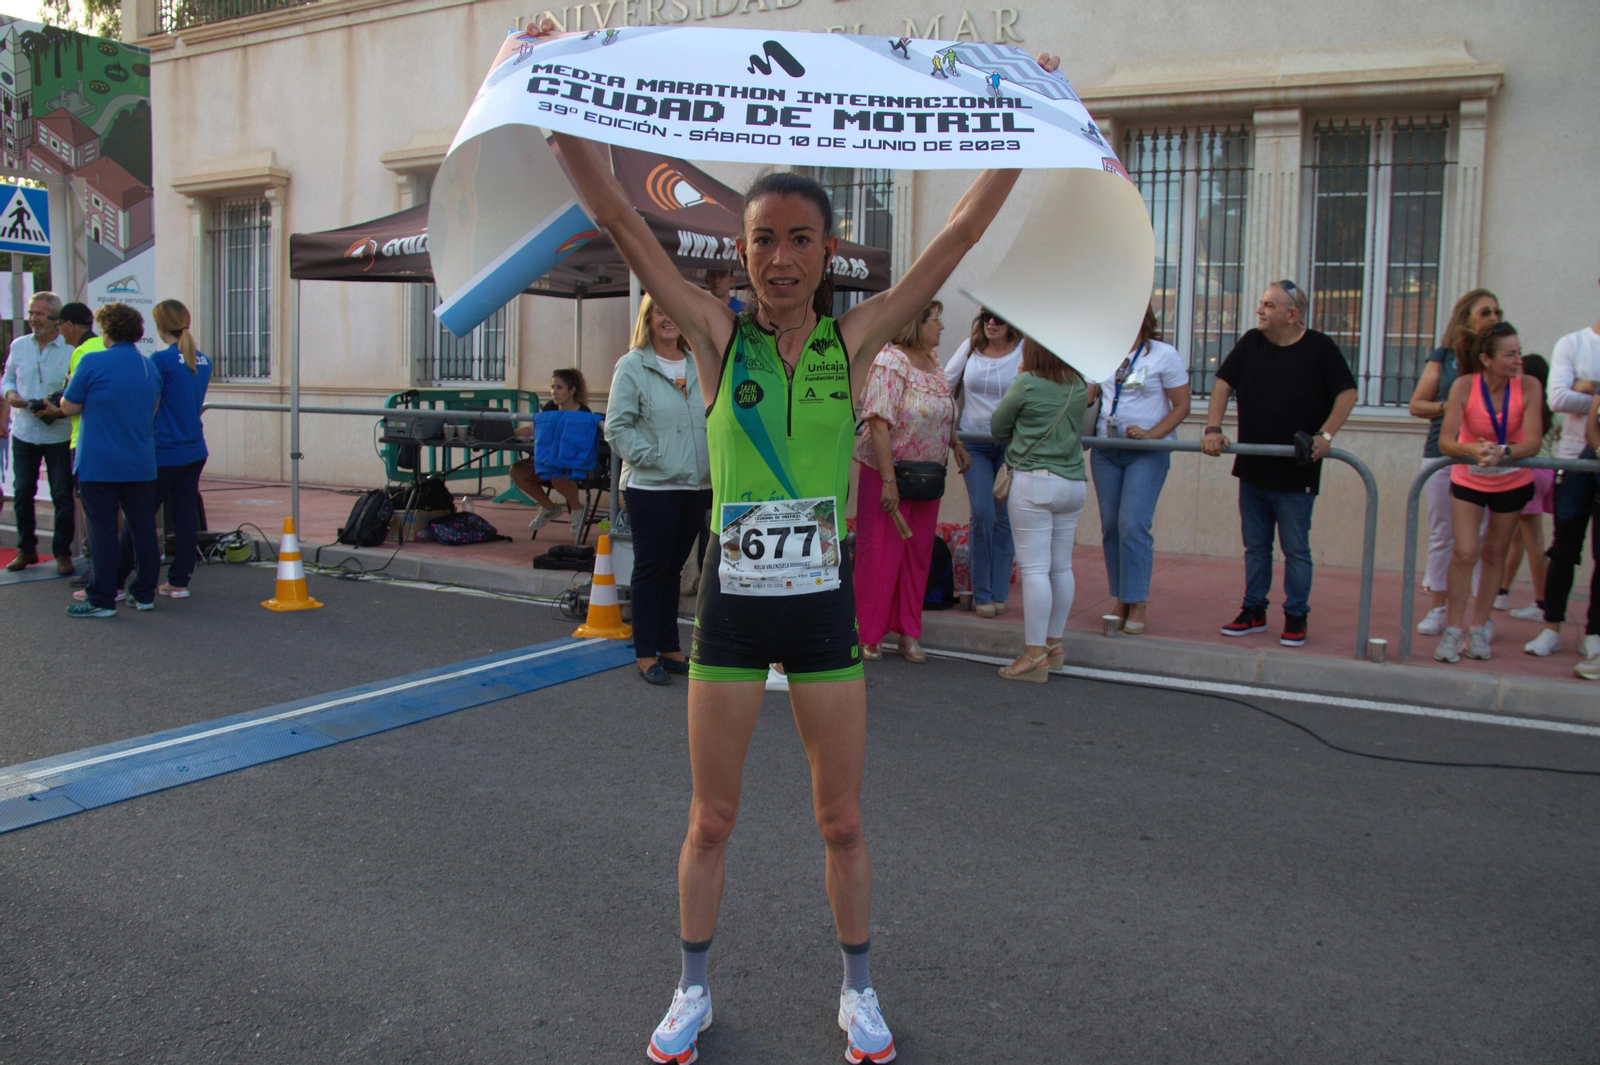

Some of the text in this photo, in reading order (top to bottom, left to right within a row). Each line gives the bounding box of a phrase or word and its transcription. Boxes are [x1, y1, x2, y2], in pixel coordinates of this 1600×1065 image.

[513, 0, 801, 33] NIVERSID
[902, 7, 1024, 43] MAR
[527, 76, 1035, 133] CIUDAD DE MOTRIL
[531, 64, 1033, 109] MEDIA MARATHON INTERNACIONAL
[584, 112, 667, 137] EDICIÓN
[689, 127, 781, 145] SÁBADO
[788, 135, 810, 147] 10
[817, 136, 846, 148] DE
[852, 139, 916, 152] JUNIO
[923, 140, 953, 152] DE
[959, 140, 1021, 151] 2023
[808, 360, 844, 372] Unicaja
[741, 525, 817, 560] 677
